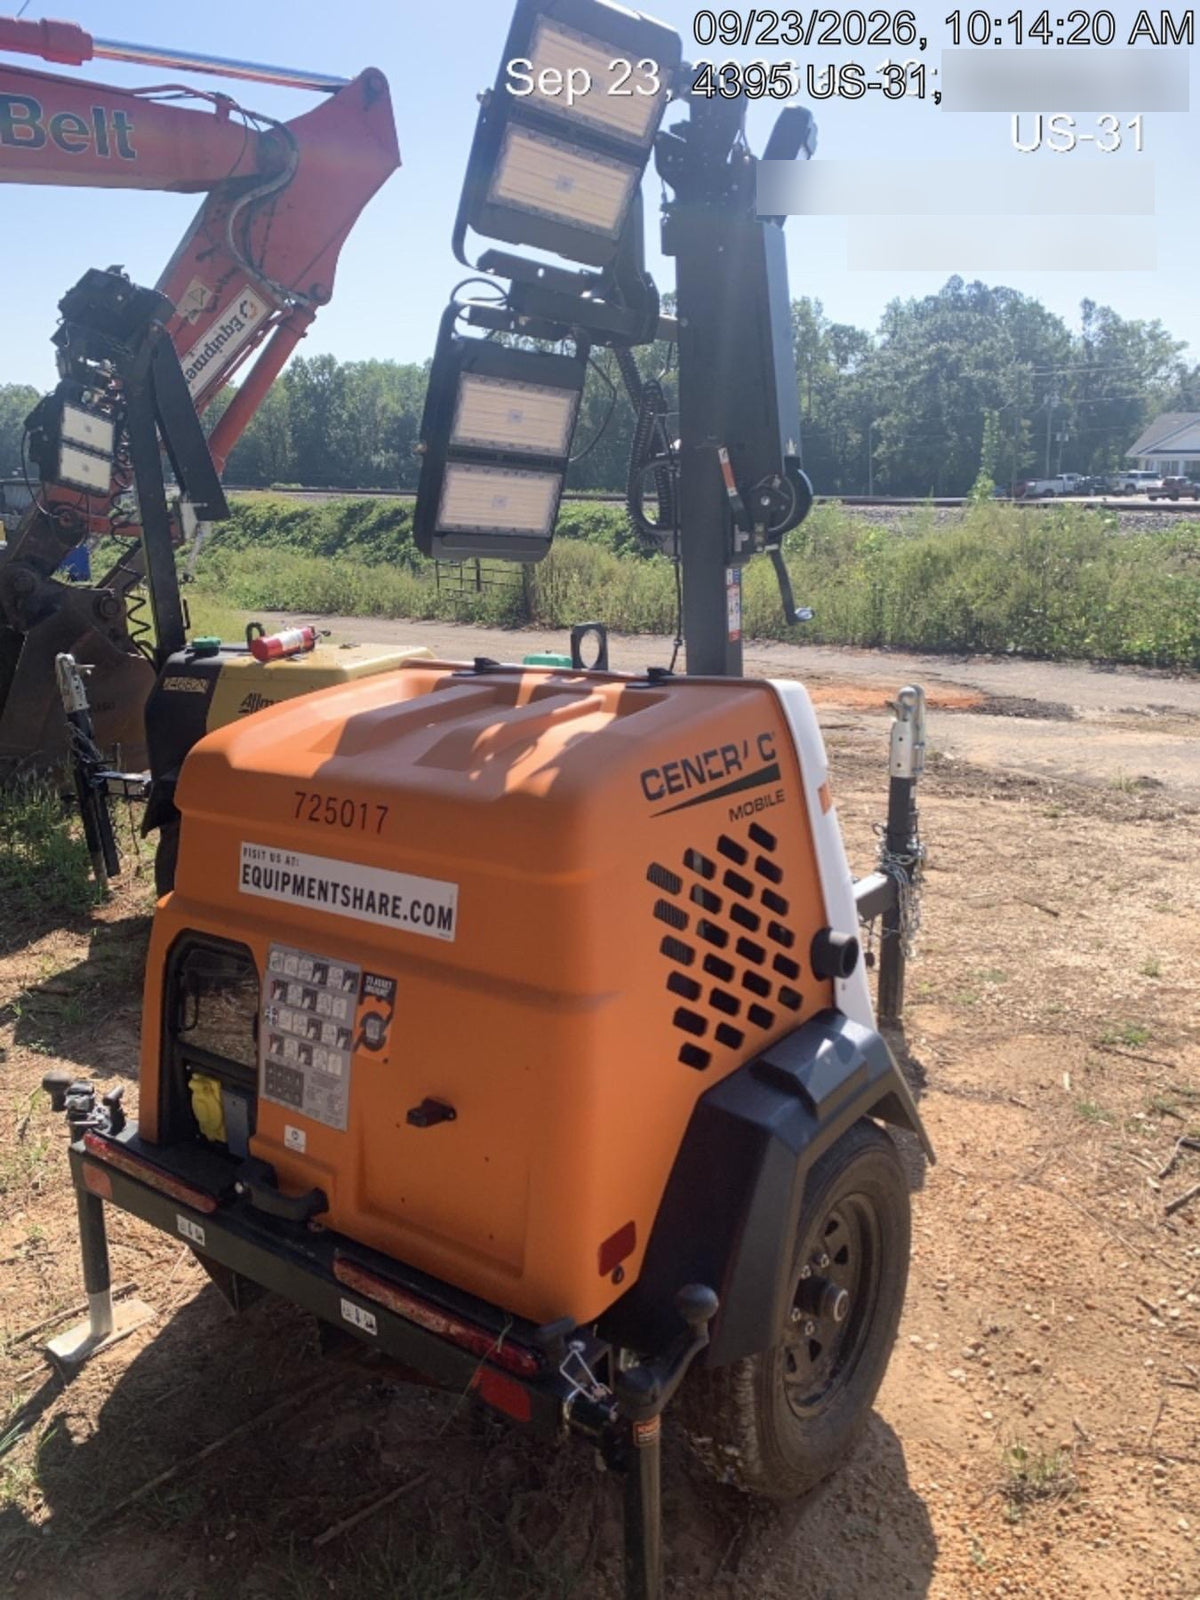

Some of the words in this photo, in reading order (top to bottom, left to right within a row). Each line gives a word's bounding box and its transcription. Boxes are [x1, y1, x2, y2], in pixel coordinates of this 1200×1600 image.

[0, 92, 138, 161] Belt
[185, 315, 246, 384] Equipme
[294, 791, 389, 835] 725017
[728, 789, 786, 822] MOBILE
[243, 847, 267, 861] VISIT
[269, 852, 282, 864] US
[242, 864, 452, 931] EQUIPMENTSHARE.COM
